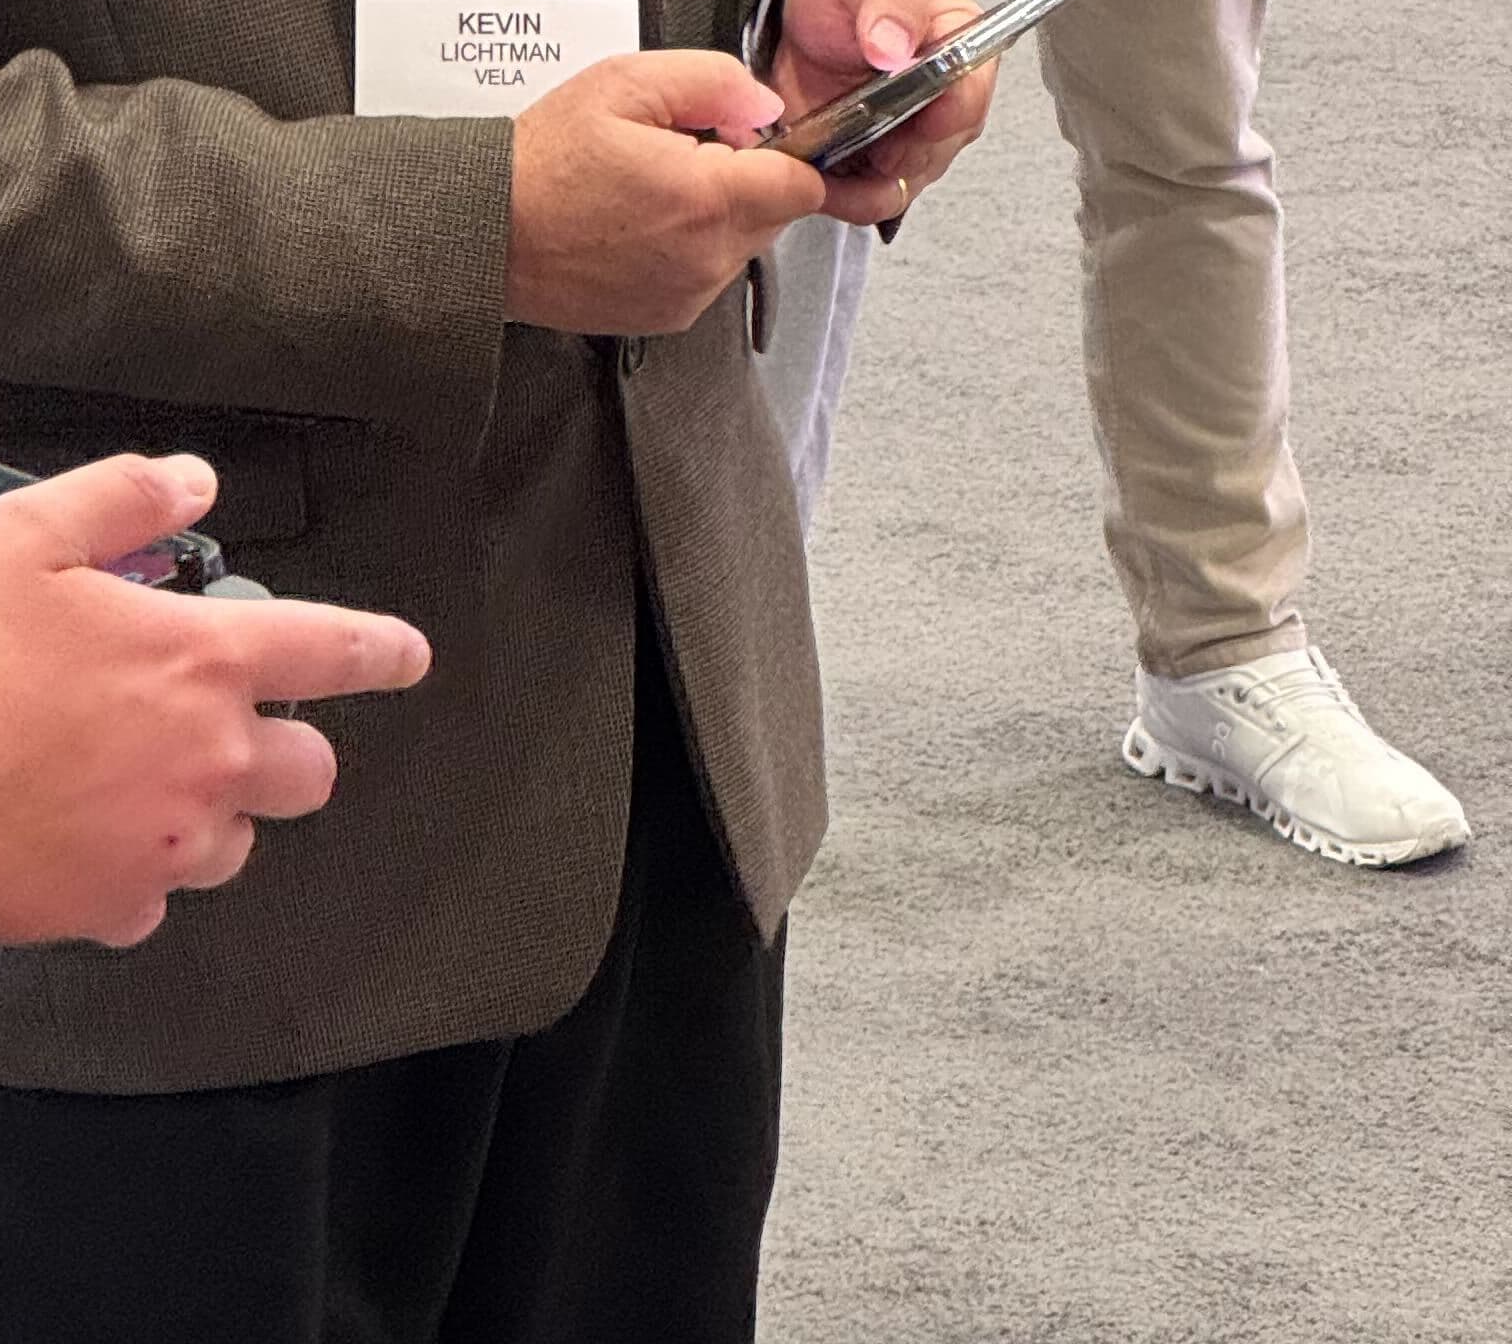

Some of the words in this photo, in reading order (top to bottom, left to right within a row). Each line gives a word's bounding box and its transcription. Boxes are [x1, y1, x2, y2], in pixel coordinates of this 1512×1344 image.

[459, 13, 541, 35] KEVIN
[441, 42, 561, 63] LICHTMAN
[475, 69, 525, 86] VELA
